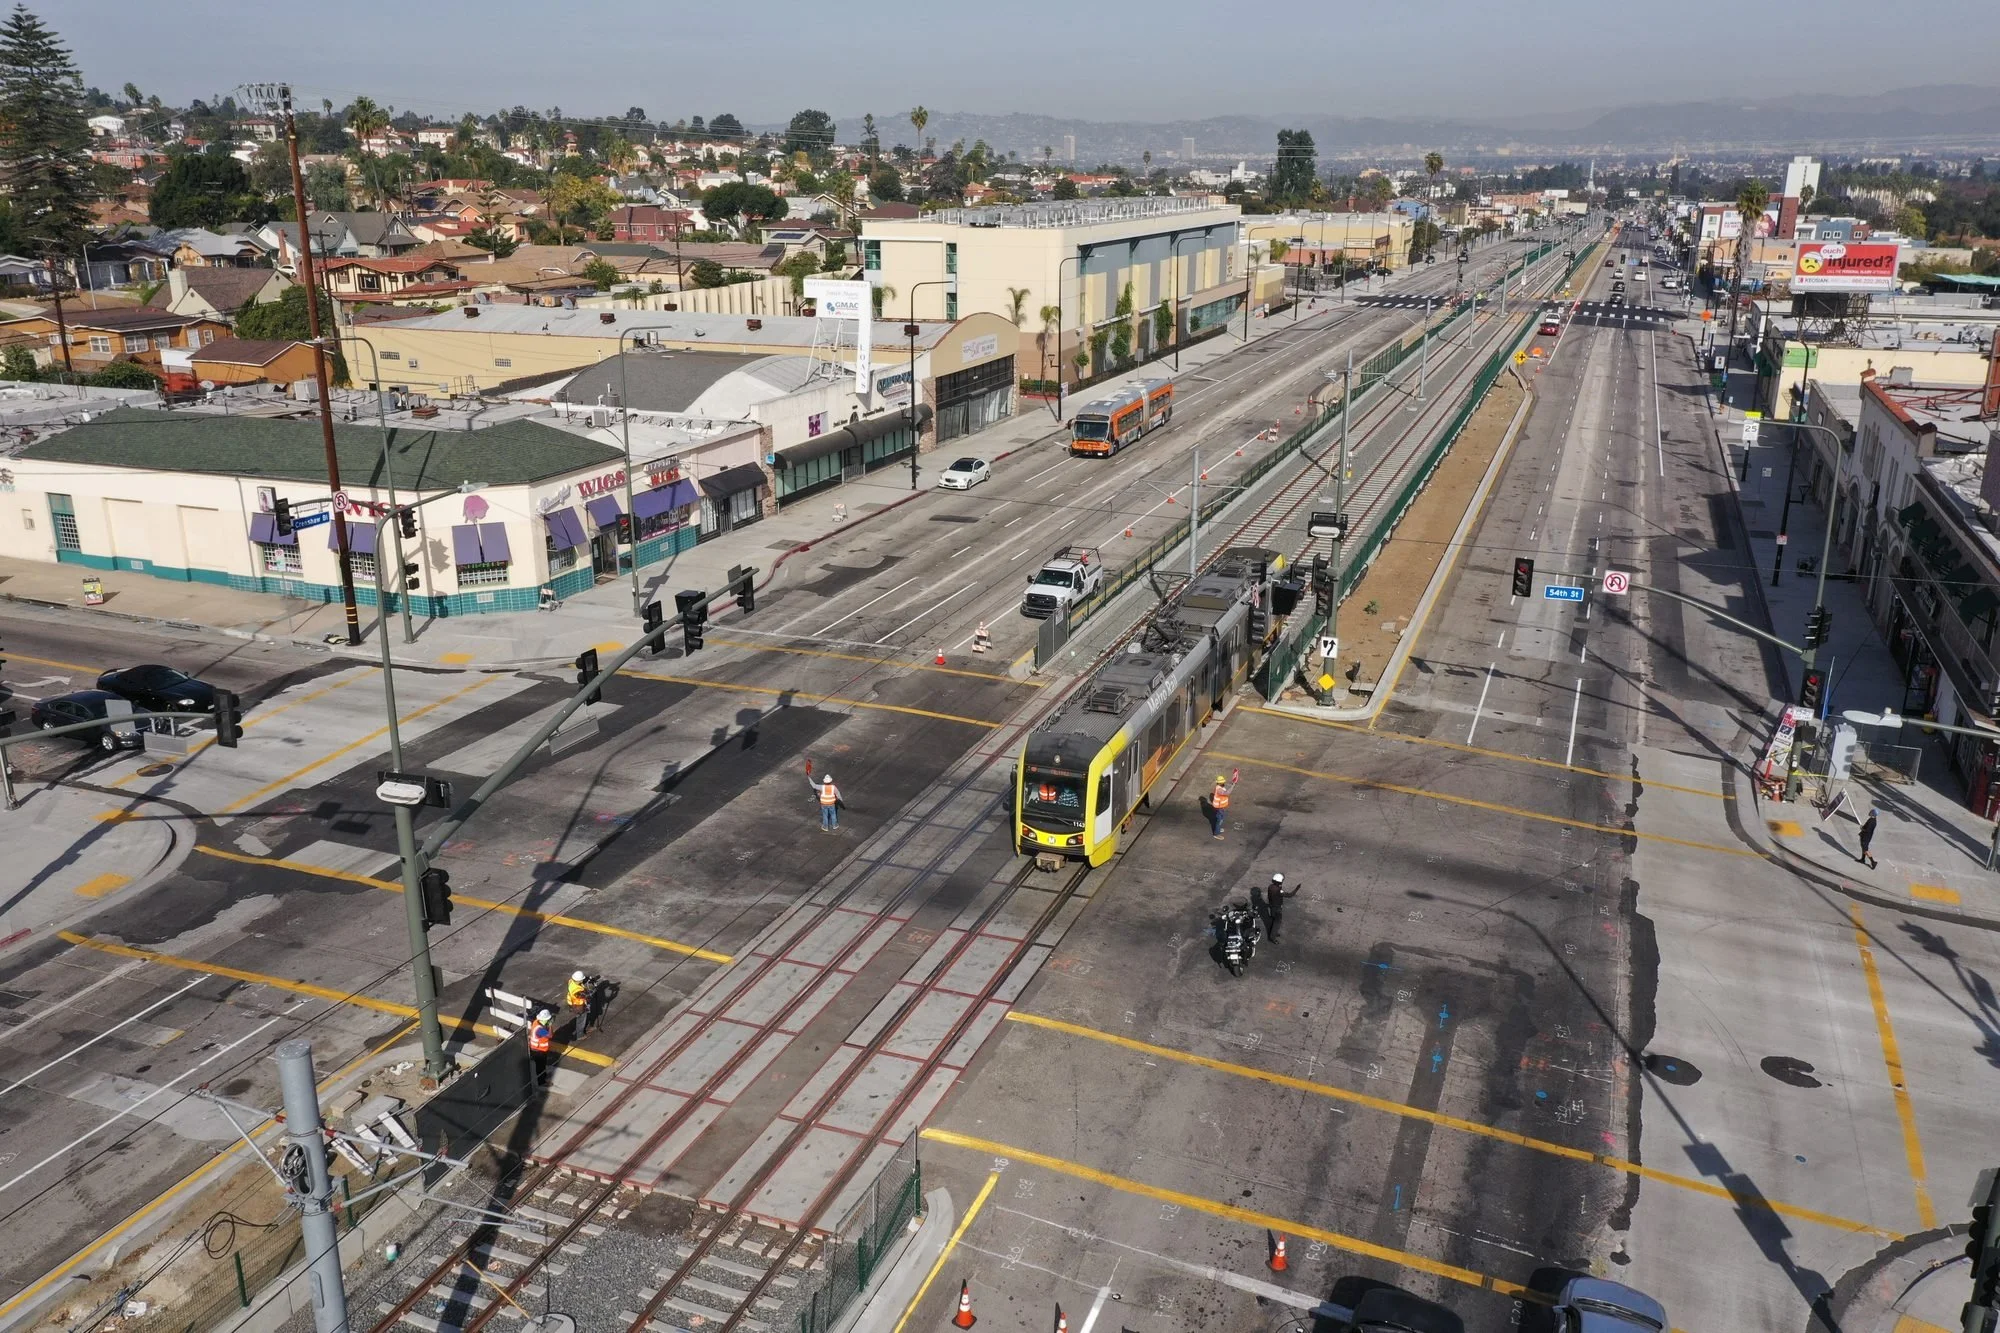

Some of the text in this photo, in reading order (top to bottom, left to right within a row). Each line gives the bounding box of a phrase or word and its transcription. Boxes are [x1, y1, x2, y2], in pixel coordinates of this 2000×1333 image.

[1828, 255, 1893, 269] injured?
[576, 470, 628, 498] WIGS
[294, 516, 321, 529] Crenshaw
[1549, 588, 1579, 598] 54th St
[1147, 674, 1178, 716] Metro Rail
